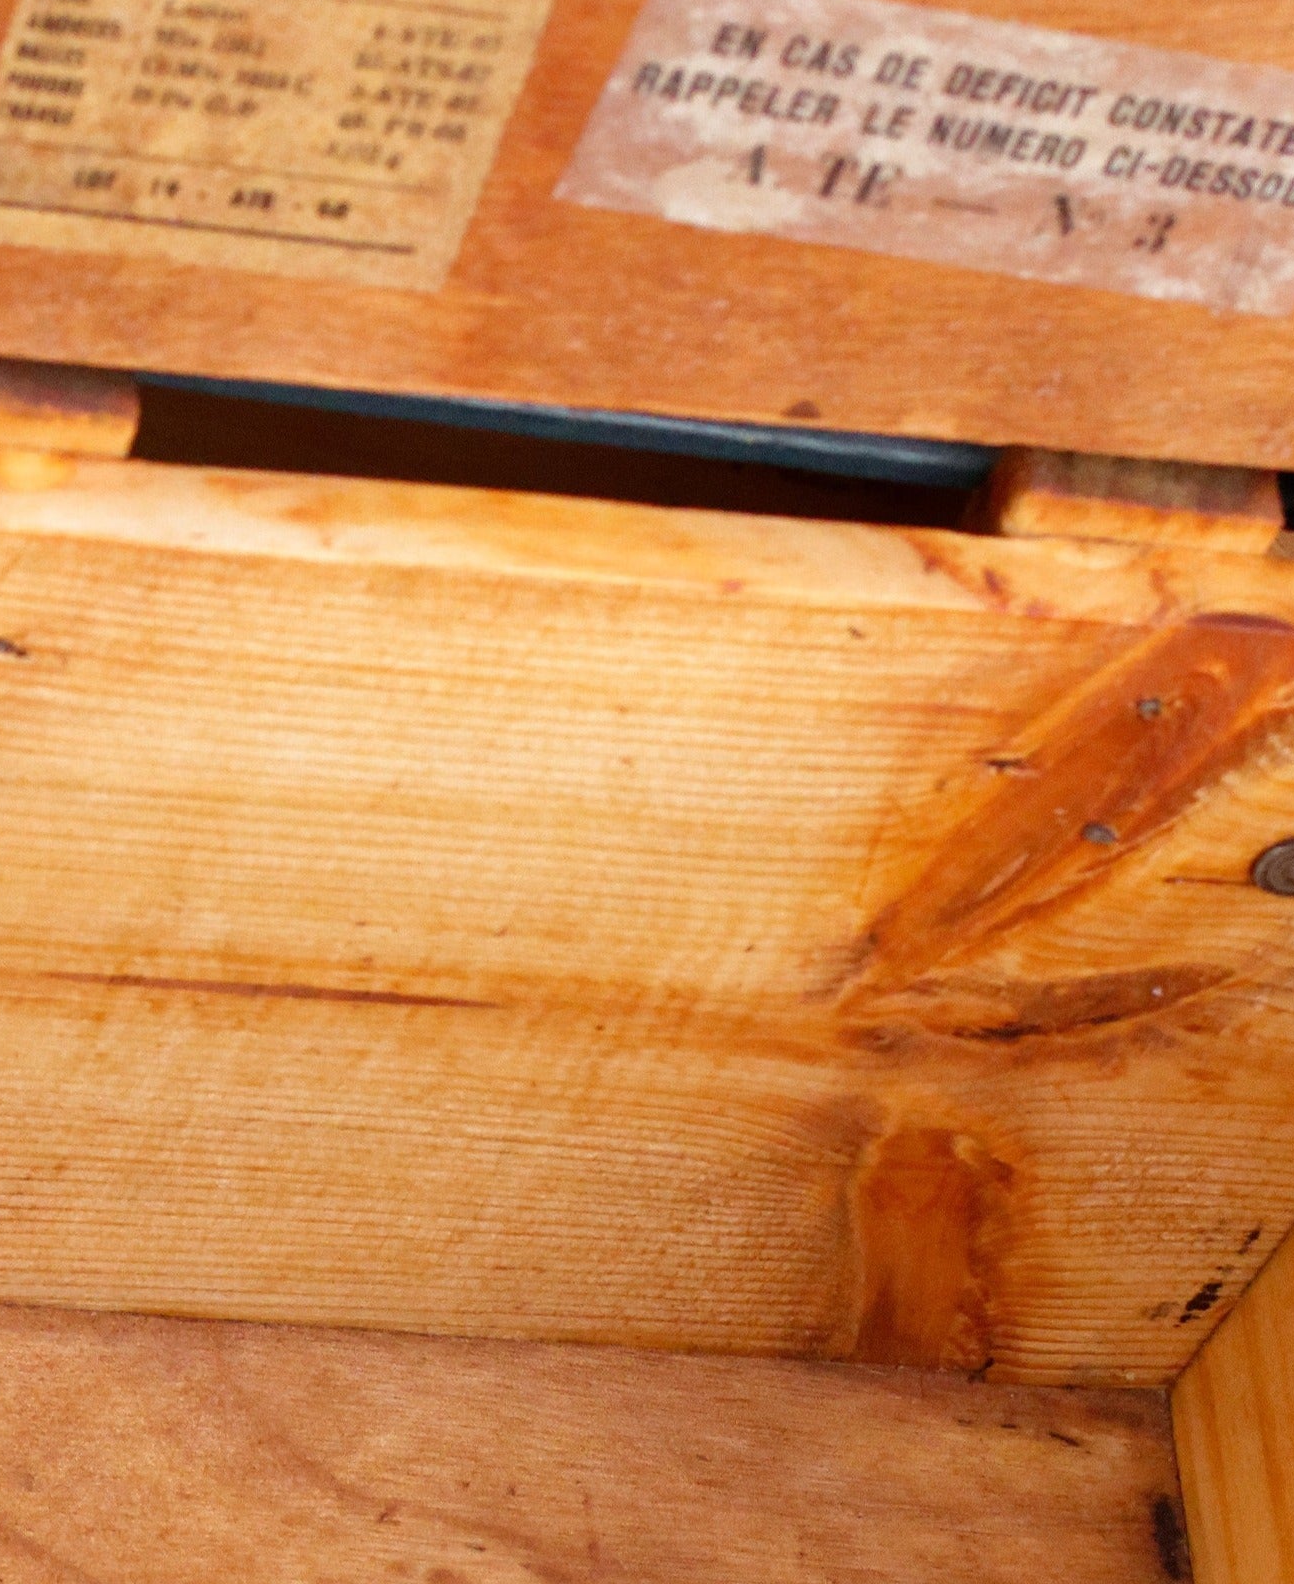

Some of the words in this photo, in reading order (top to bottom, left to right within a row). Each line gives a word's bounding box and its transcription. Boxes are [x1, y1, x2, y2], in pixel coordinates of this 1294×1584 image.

[631, 61, 842, 126] RAPPELER
[860, 102, 918, 141] LE
[926, 113, 1089, 170] NUMERO
[711, 21, 769, 61] EN
[779, 33, 861, 79] CAS
[874, 51, 933, 92] DE
[942, 61, 1100, 119] DEFICIT
